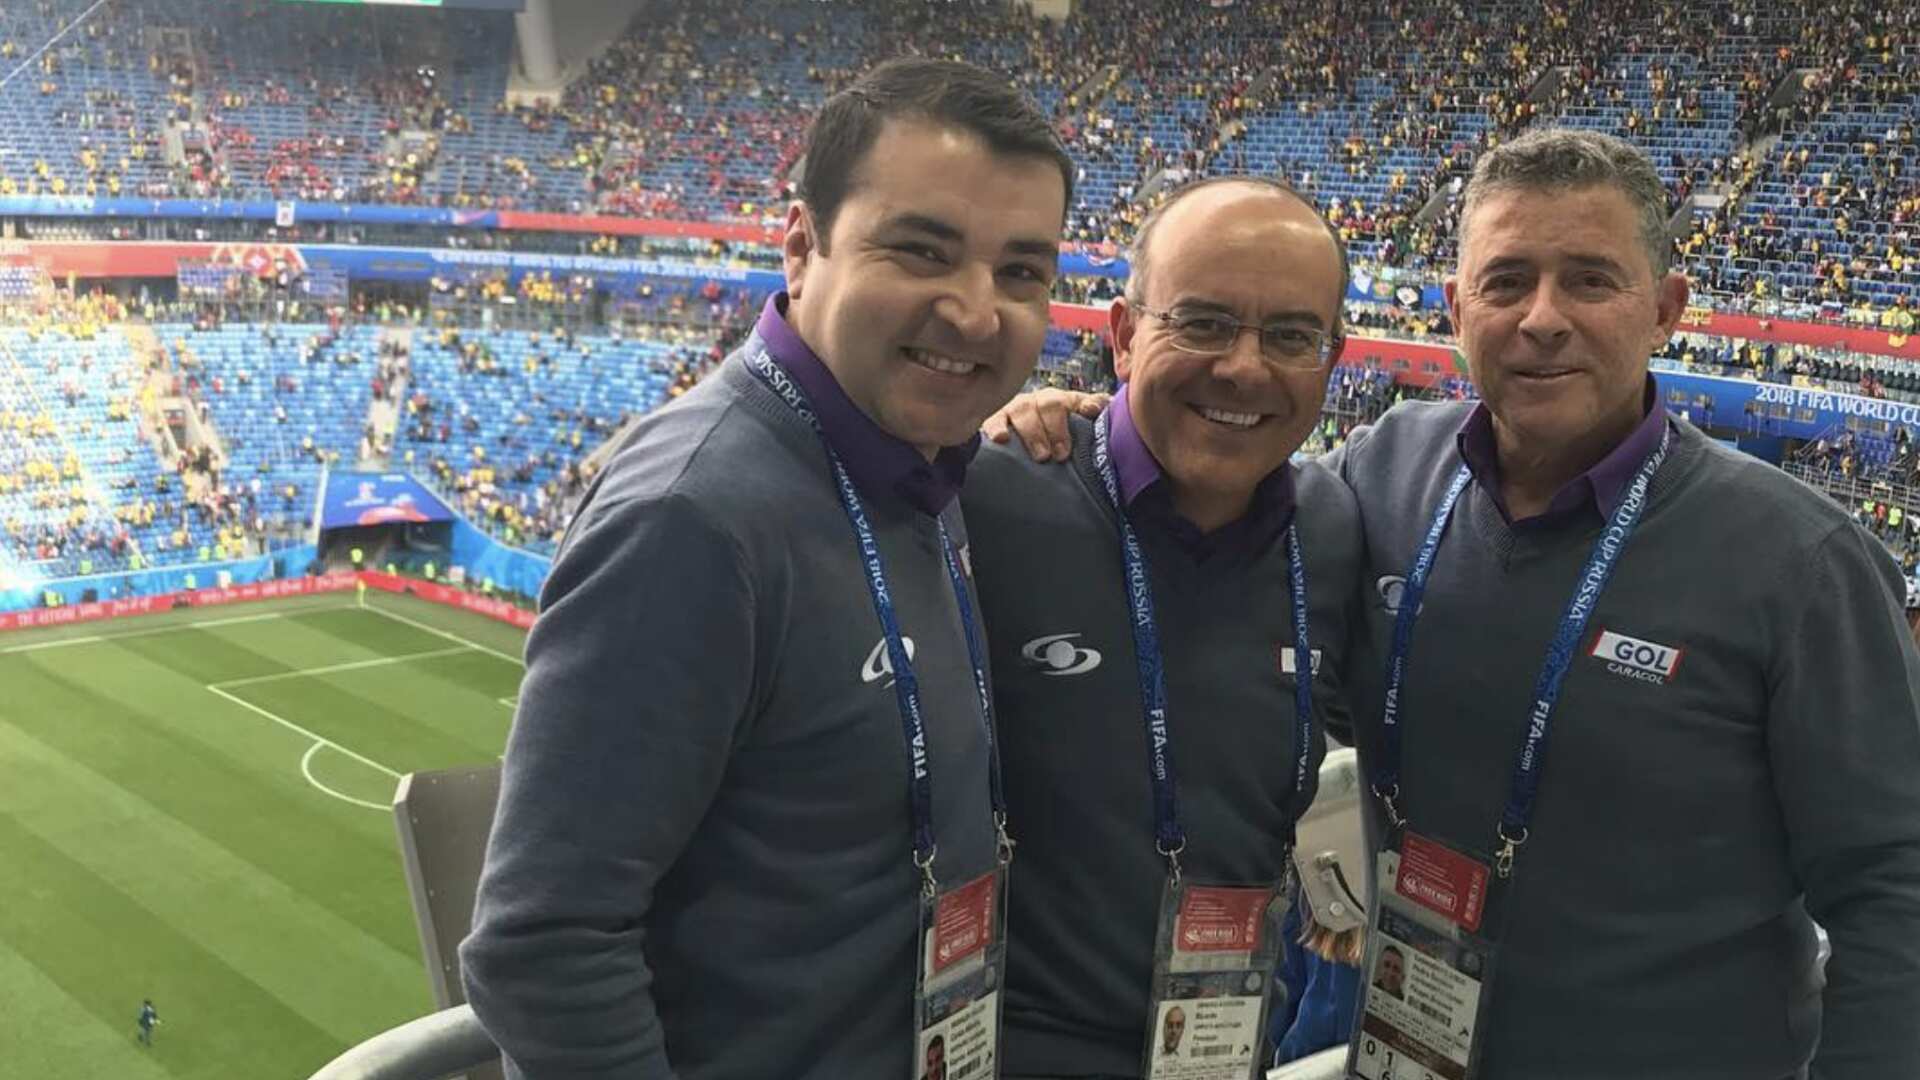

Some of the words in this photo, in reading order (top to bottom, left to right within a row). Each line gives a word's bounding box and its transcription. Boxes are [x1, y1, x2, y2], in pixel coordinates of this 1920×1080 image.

[753, 350, 802, 407] RUSSIA
[1755, 385, 1795, 405] 2018
[1797, 391, 1834, 412] FIFA
[1836, 396, 1898, 421] WORLD
[1615, 474, 1650, 526] WORLD
[855, 513, 876, 556] FIFA
[1601, 526, 1625, 560] CUP
[868, 558, 891, 603] 2018
[1130, 561, 1151, 626] RUSSIA
[1568, 560, 1607, 620] RUSSIA
[1606, 662, 1664, 685] CARACOL
[1614, 640, 1669, 671] GOL
[976, 668, 993, 744] FIFA.
[1384, 656, 1402, 725] FIFA.com
[908, 694, 928, 779] FIFA.com
[1150, 708, 1167, 780] FIFA.com
[1521, 700, 1550, 771] FIFA.com
[1366, 1039, 1376, 1056] 0
[1386, 1051, 1394, 1067] 1
